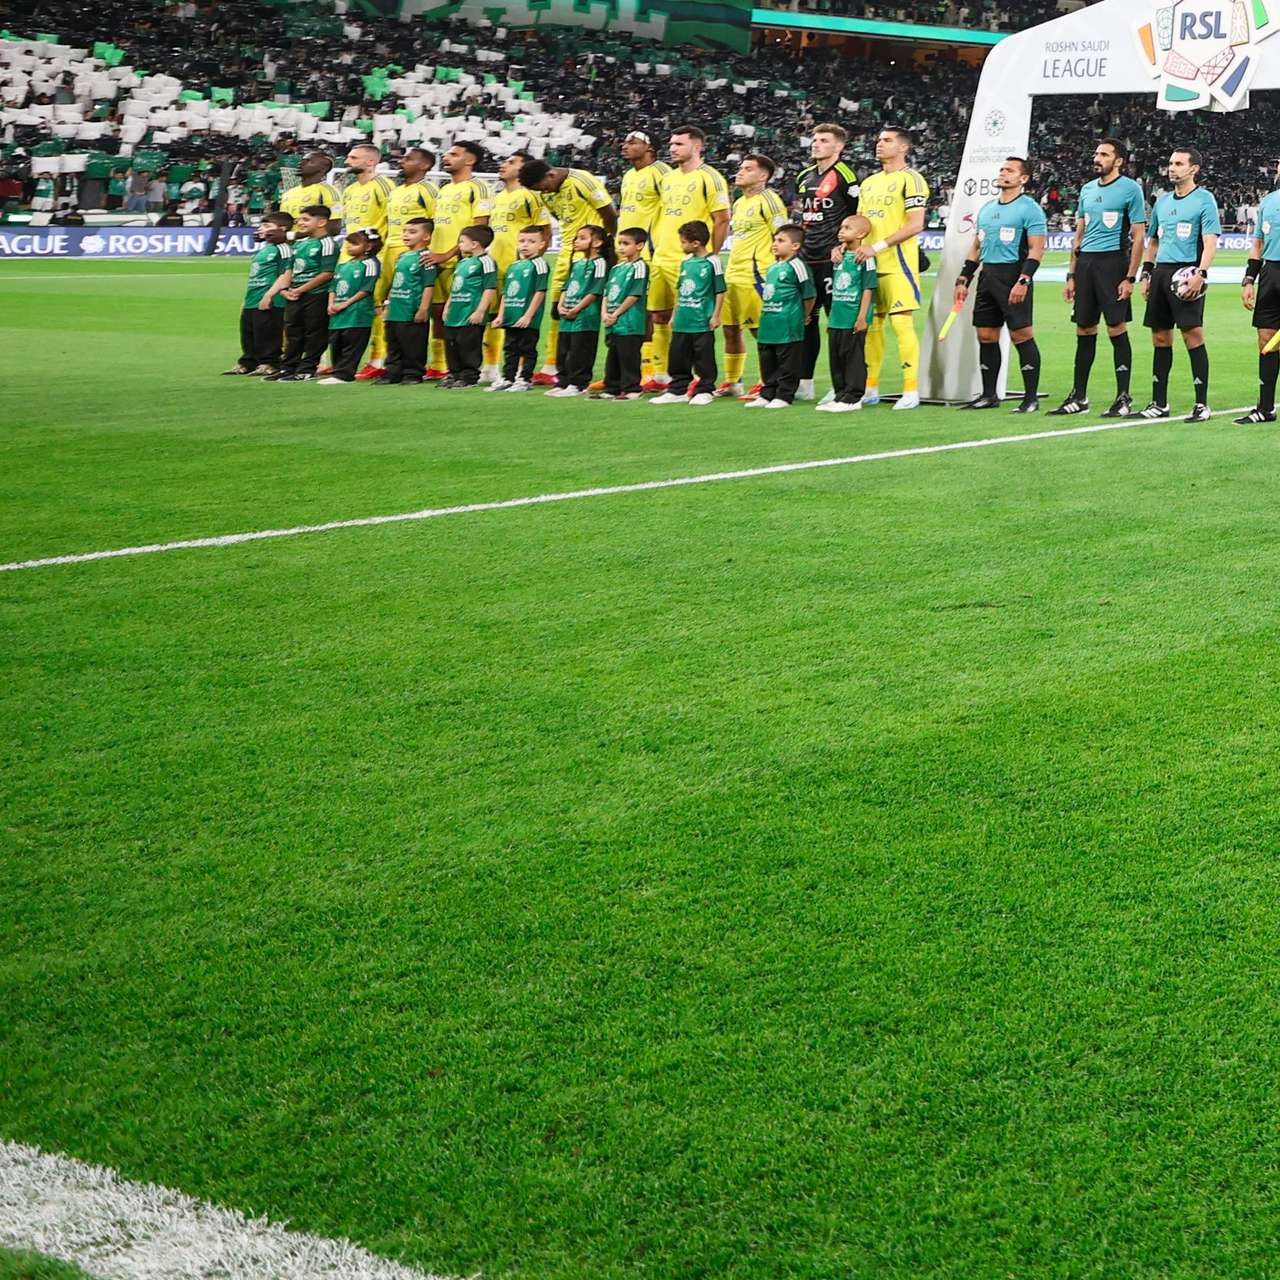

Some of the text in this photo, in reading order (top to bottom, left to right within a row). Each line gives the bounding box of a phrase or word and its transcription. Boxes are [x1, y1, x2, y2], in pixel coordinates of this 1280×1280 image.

[1179, 10, 1227, 41] RSL
[1045, 39, 1110, 53] ROSHN SAUDI
[1042, 57, 1108, 79] LEAGUE
[109, 234, 204, 254] ROSHN
[215, 235, 267, 254] SAU
